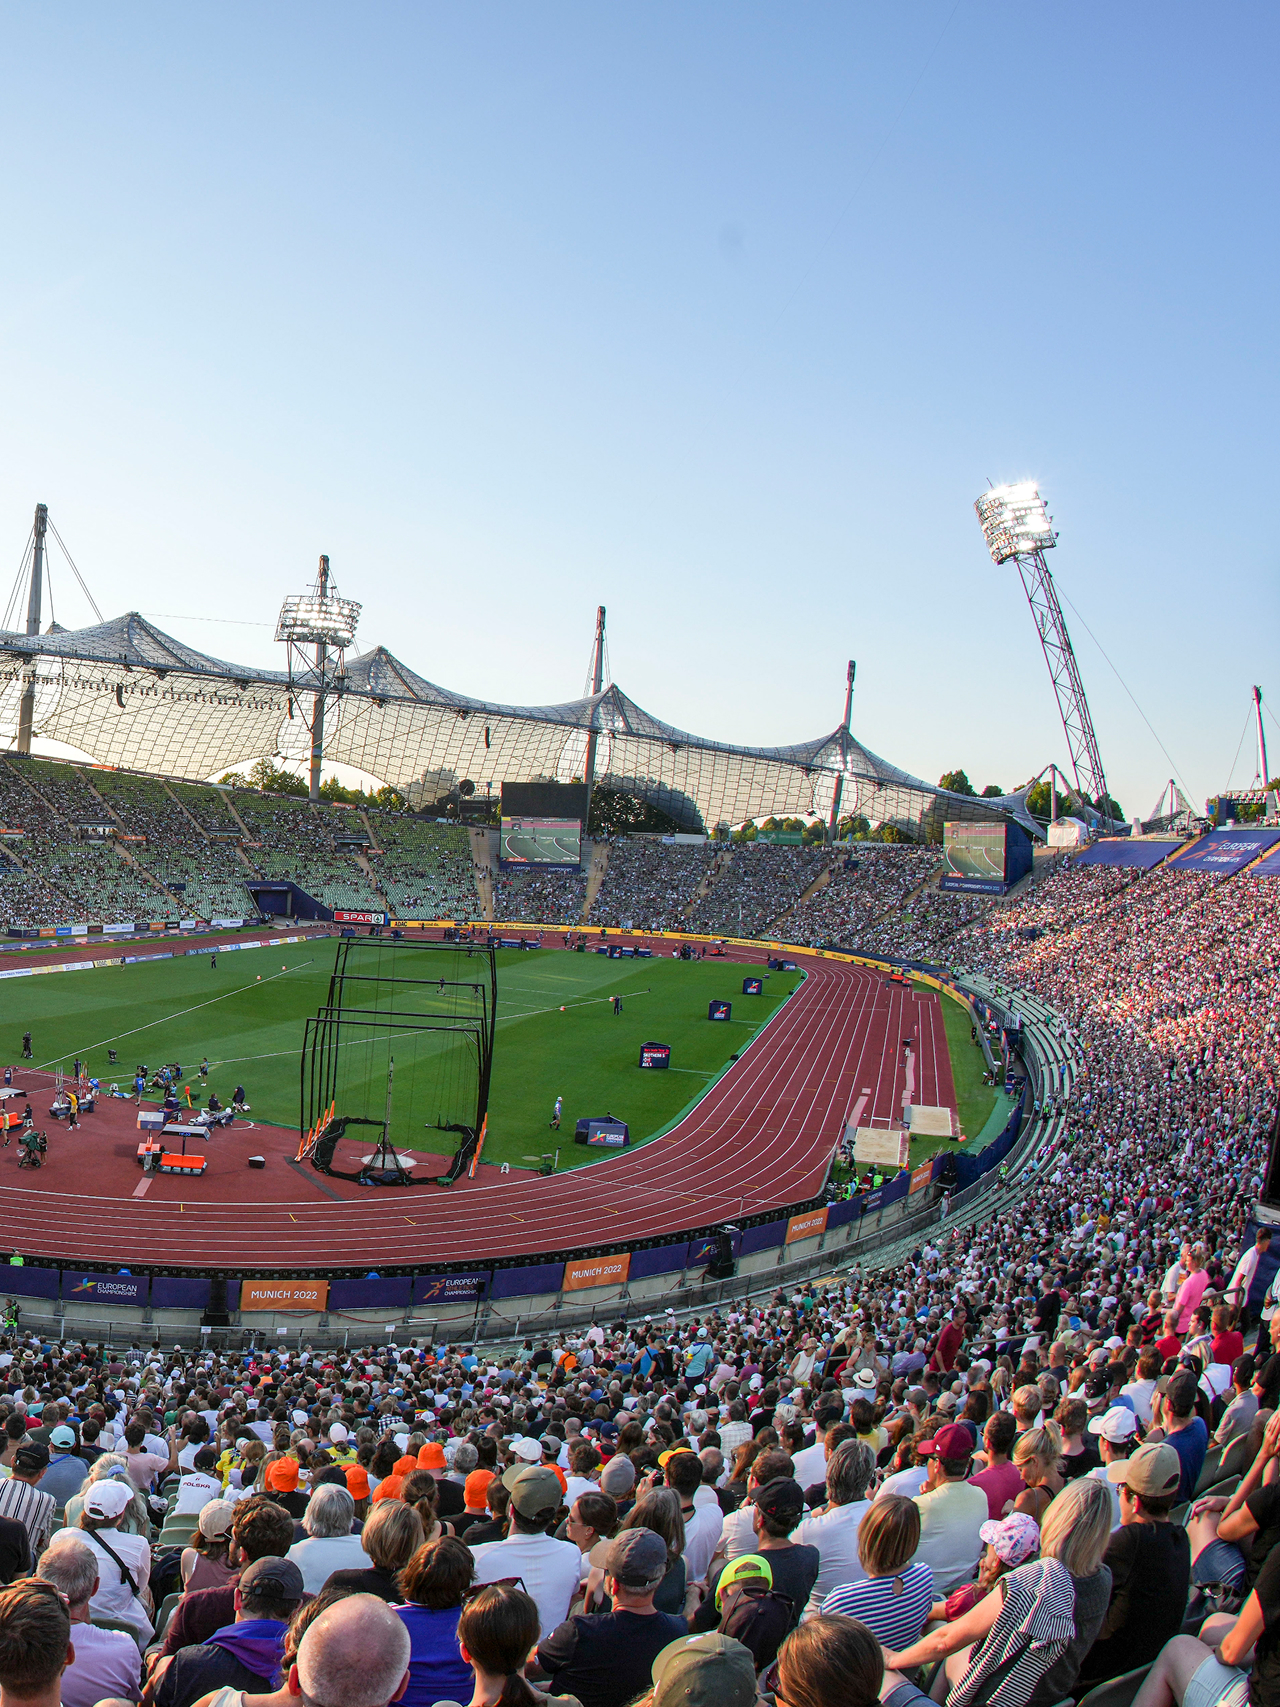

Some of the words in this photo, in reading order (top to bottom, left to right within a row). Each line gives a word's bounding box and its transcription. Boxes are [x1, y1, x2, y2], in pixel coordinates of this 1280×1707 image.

[343, 914, 372, 922] SPAR
[791, 1220, 811, 1233] MUNICH
[811, 1217, 824, 1227] 2022
[571, 1267, 602, 1280] MUNICH
[603, 1264, 622, 1275] 2022
[97, 1282, 138, 1292] EUROPEAN
[97, 1289, 138, 1297] CHAMPIONSHIPS
[251, 1290, 291, 1299] MUNICH
[293, 1290, 318, 1300] 2022
[182, 1481, 211, 1489] POLSKA
